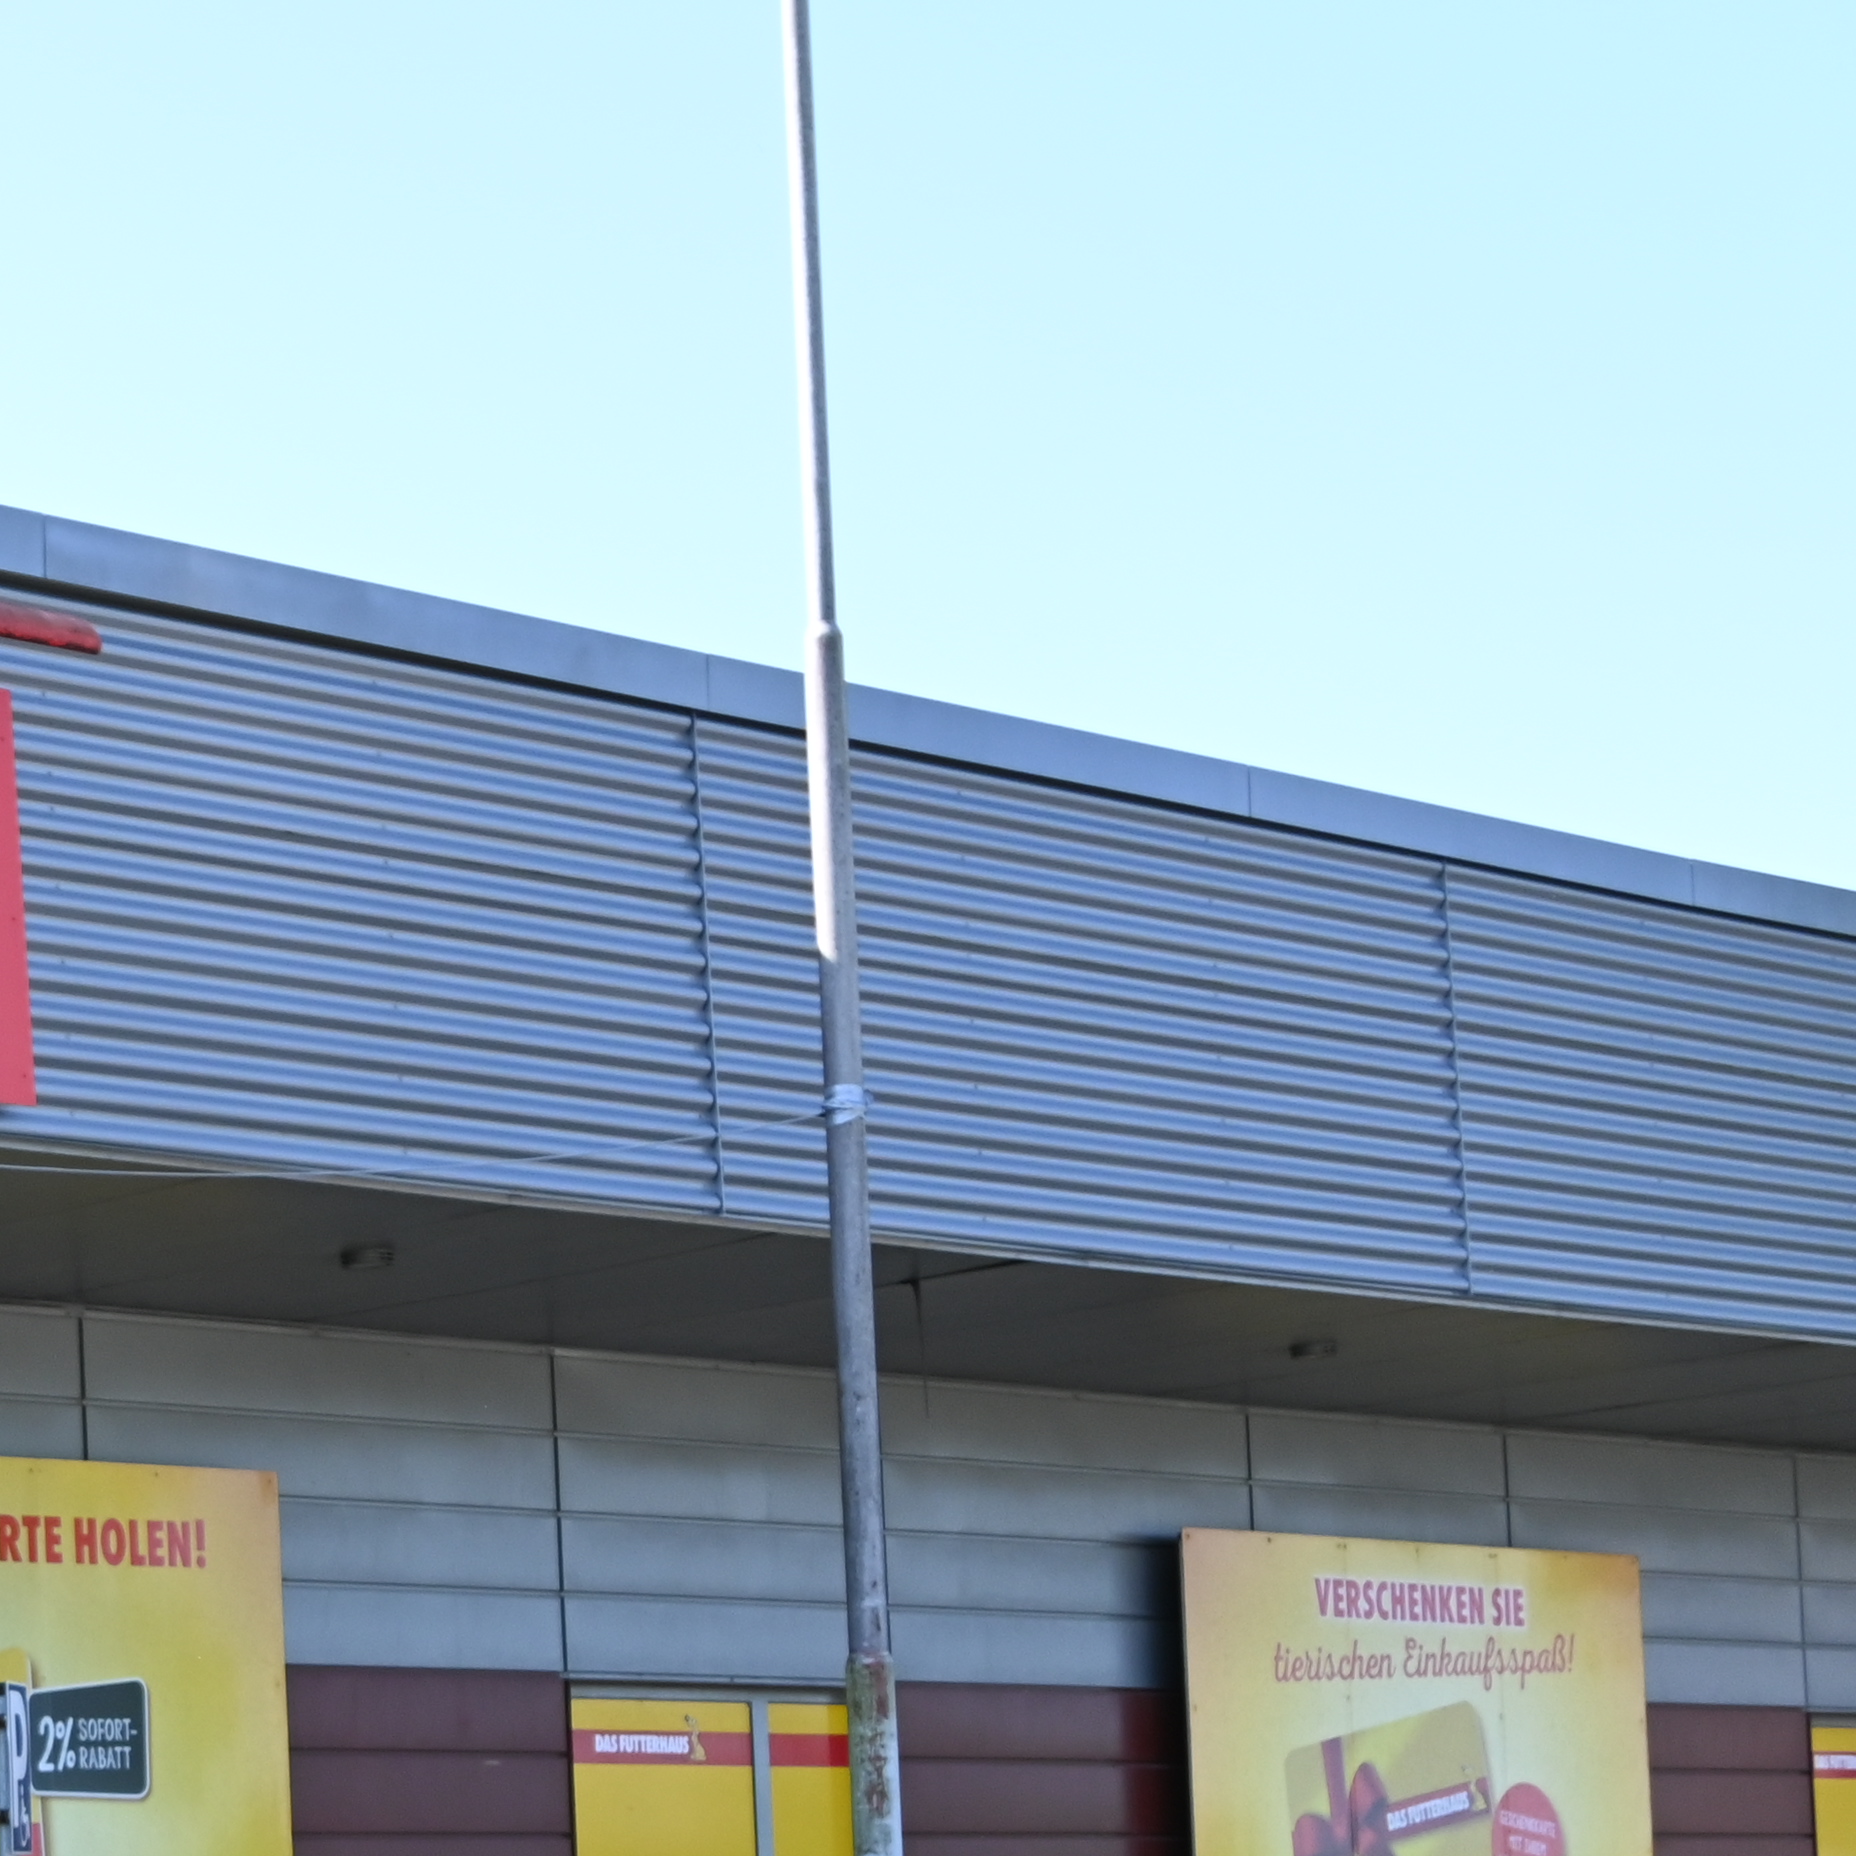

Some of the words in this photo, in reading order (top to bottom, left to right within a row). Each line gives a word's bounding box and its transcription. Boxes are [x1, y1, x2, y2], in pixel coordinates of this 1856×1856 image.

[74, 1517, 207, 1568] HOLEN!
[1314, 1577, 1486, 1625] VERSCHENKEN
[1491, 1588, 1526, 1627] SIE
[1274, 1641, 1396, 1683] tierischen
[1402, 1634, 1575, 1691] Einkaufsspaß!
[38, 1715, 76, 1772] 2%
[78, 1718, 138, 1741] SOFORT-
[595, 1734, 618, 1753] DAS
[620, 1734, 689, 1754] FUTTERHAUS
[79, 1746, 132, 1769] RABATT
[1387, 1810, 1407, 1831] DAS
[1408, 1791, 1471, 1826] FUTTERHAUS
